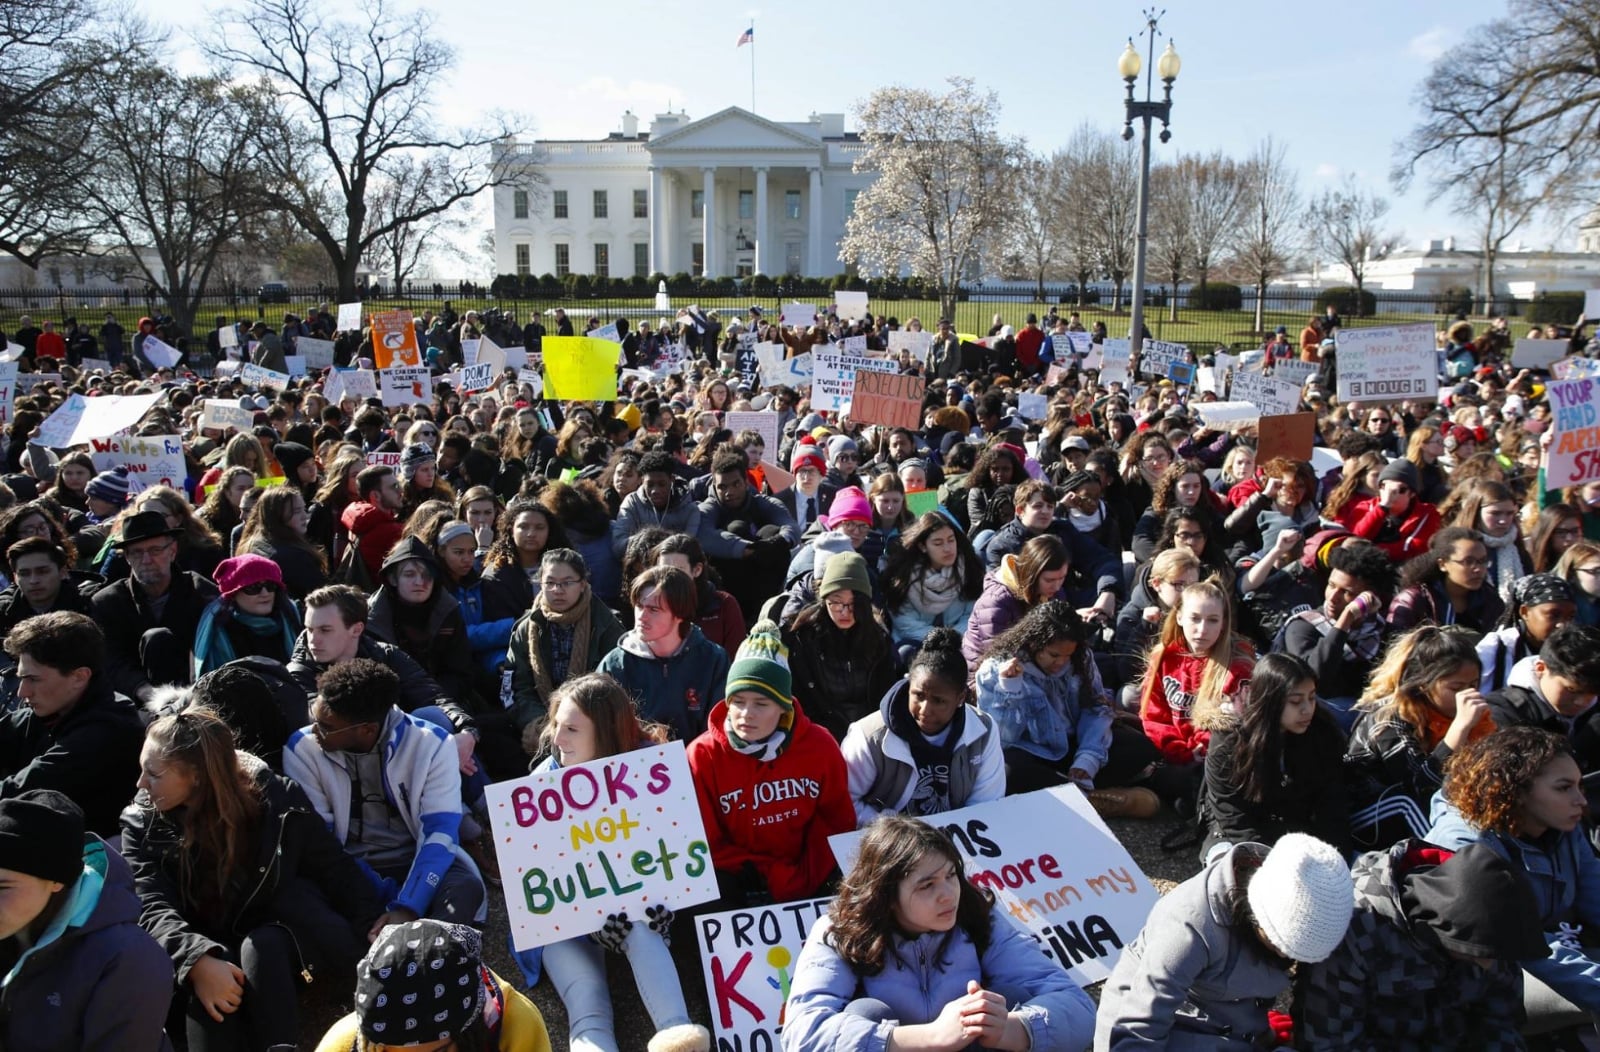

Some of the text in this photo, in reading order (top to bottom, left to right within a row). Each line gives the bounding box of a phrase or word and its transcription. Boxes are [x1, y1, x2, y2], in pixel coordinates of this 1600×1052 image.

[1552, 379, 1593, 407] YOUR
[1557, 403, 1596, 432] AND
[92, 439, 120, 453] We
[752, 778, 820, 810] JOHN'S
[968, 853, 1062, 890] more
[1009, 866, 1137, 923] than my
